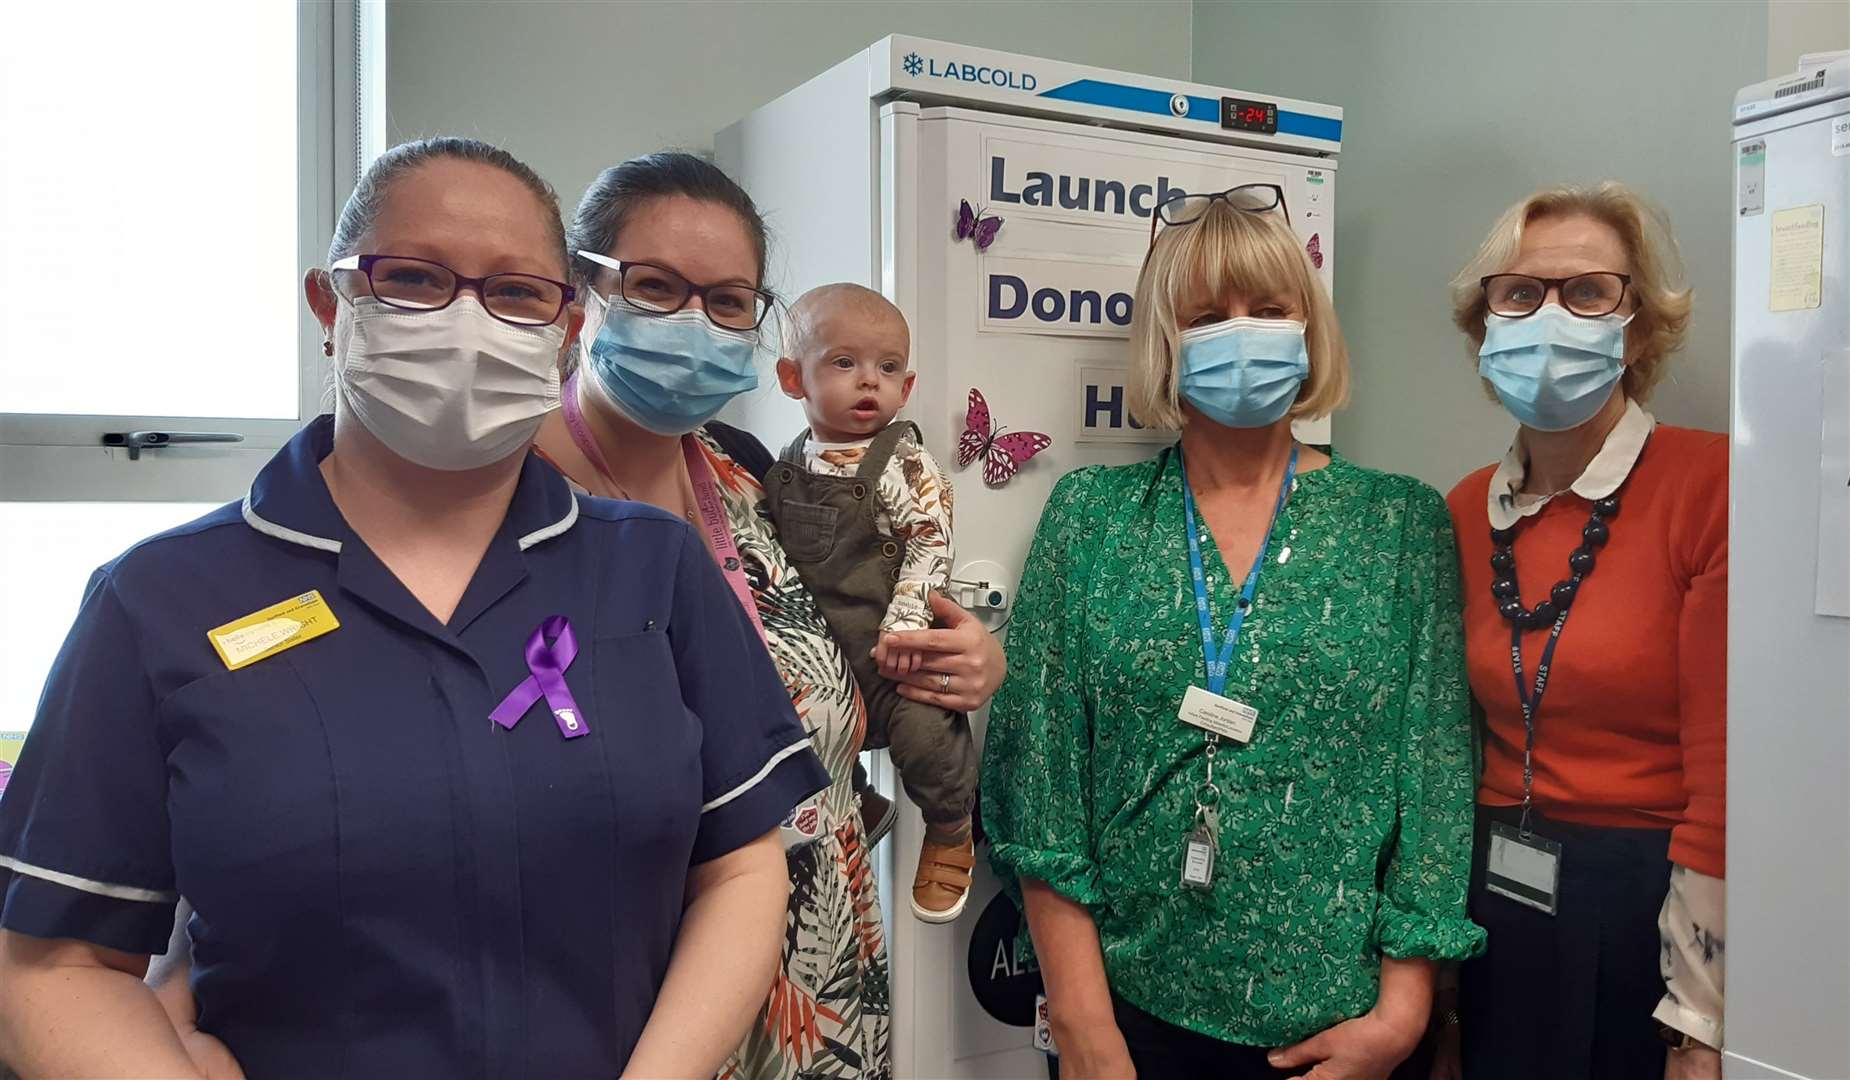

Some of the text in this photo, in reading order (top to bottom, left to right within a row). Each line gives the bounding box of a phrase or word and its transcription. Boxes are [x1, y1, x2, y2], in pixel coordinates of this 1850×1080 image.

[929, 58, 1037, 91] LABCOLD
[991, 155, 1187, 221] Launch
[1085, 384, 1146, 430] H
[1551, 609, 1568, 637] STAFF
[1535, 664, 1548, 694] STAFF
